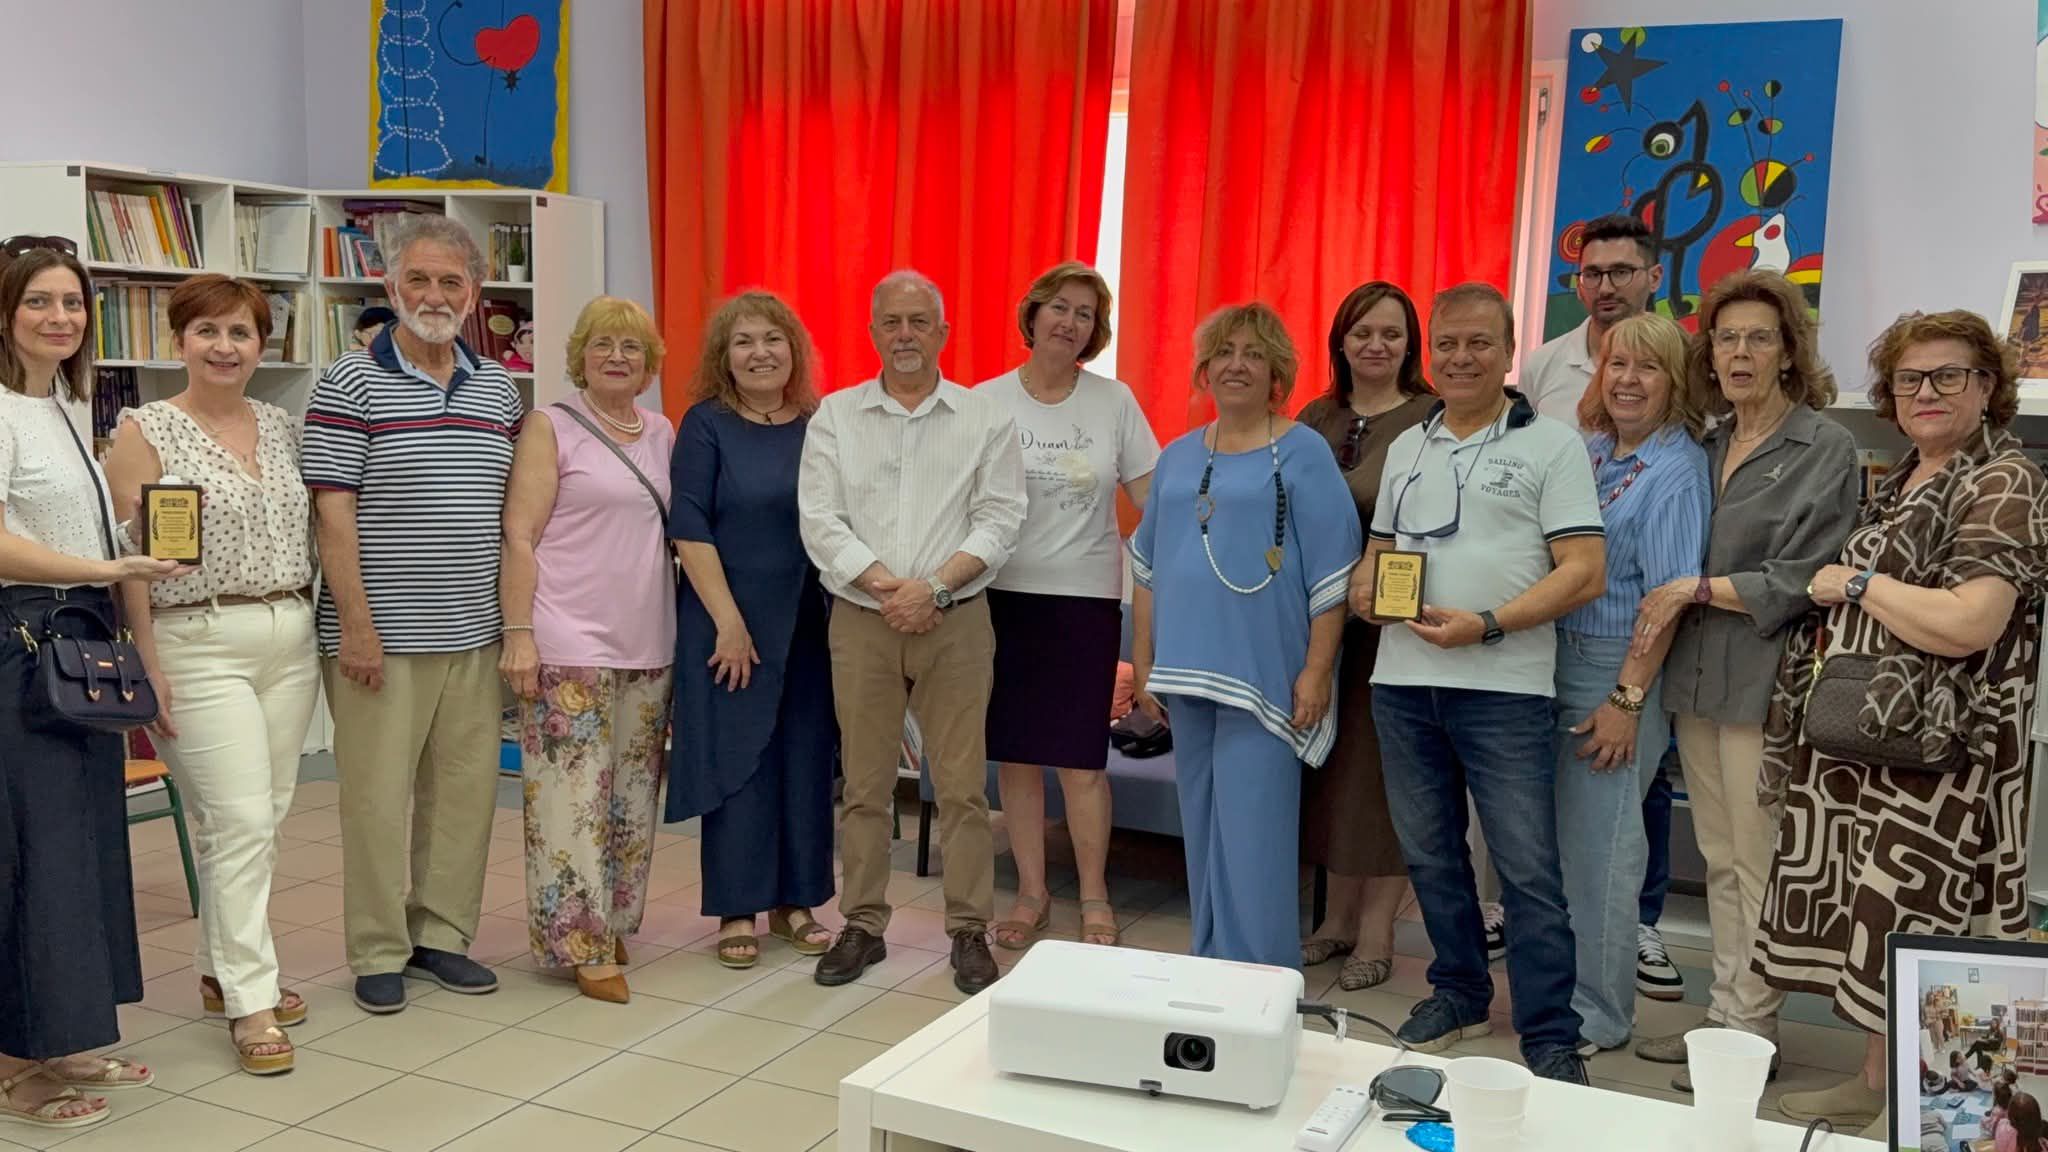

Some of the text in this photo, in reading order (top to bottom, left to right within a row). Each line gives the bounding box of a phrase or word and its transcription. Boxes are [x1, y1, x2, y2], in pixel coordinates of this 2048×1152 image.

[1019, 427, 1070, 450] Dream
[1488, 458, 1524, 469] SAILING
[1480, 483, 1521, 498] VOYAGES
